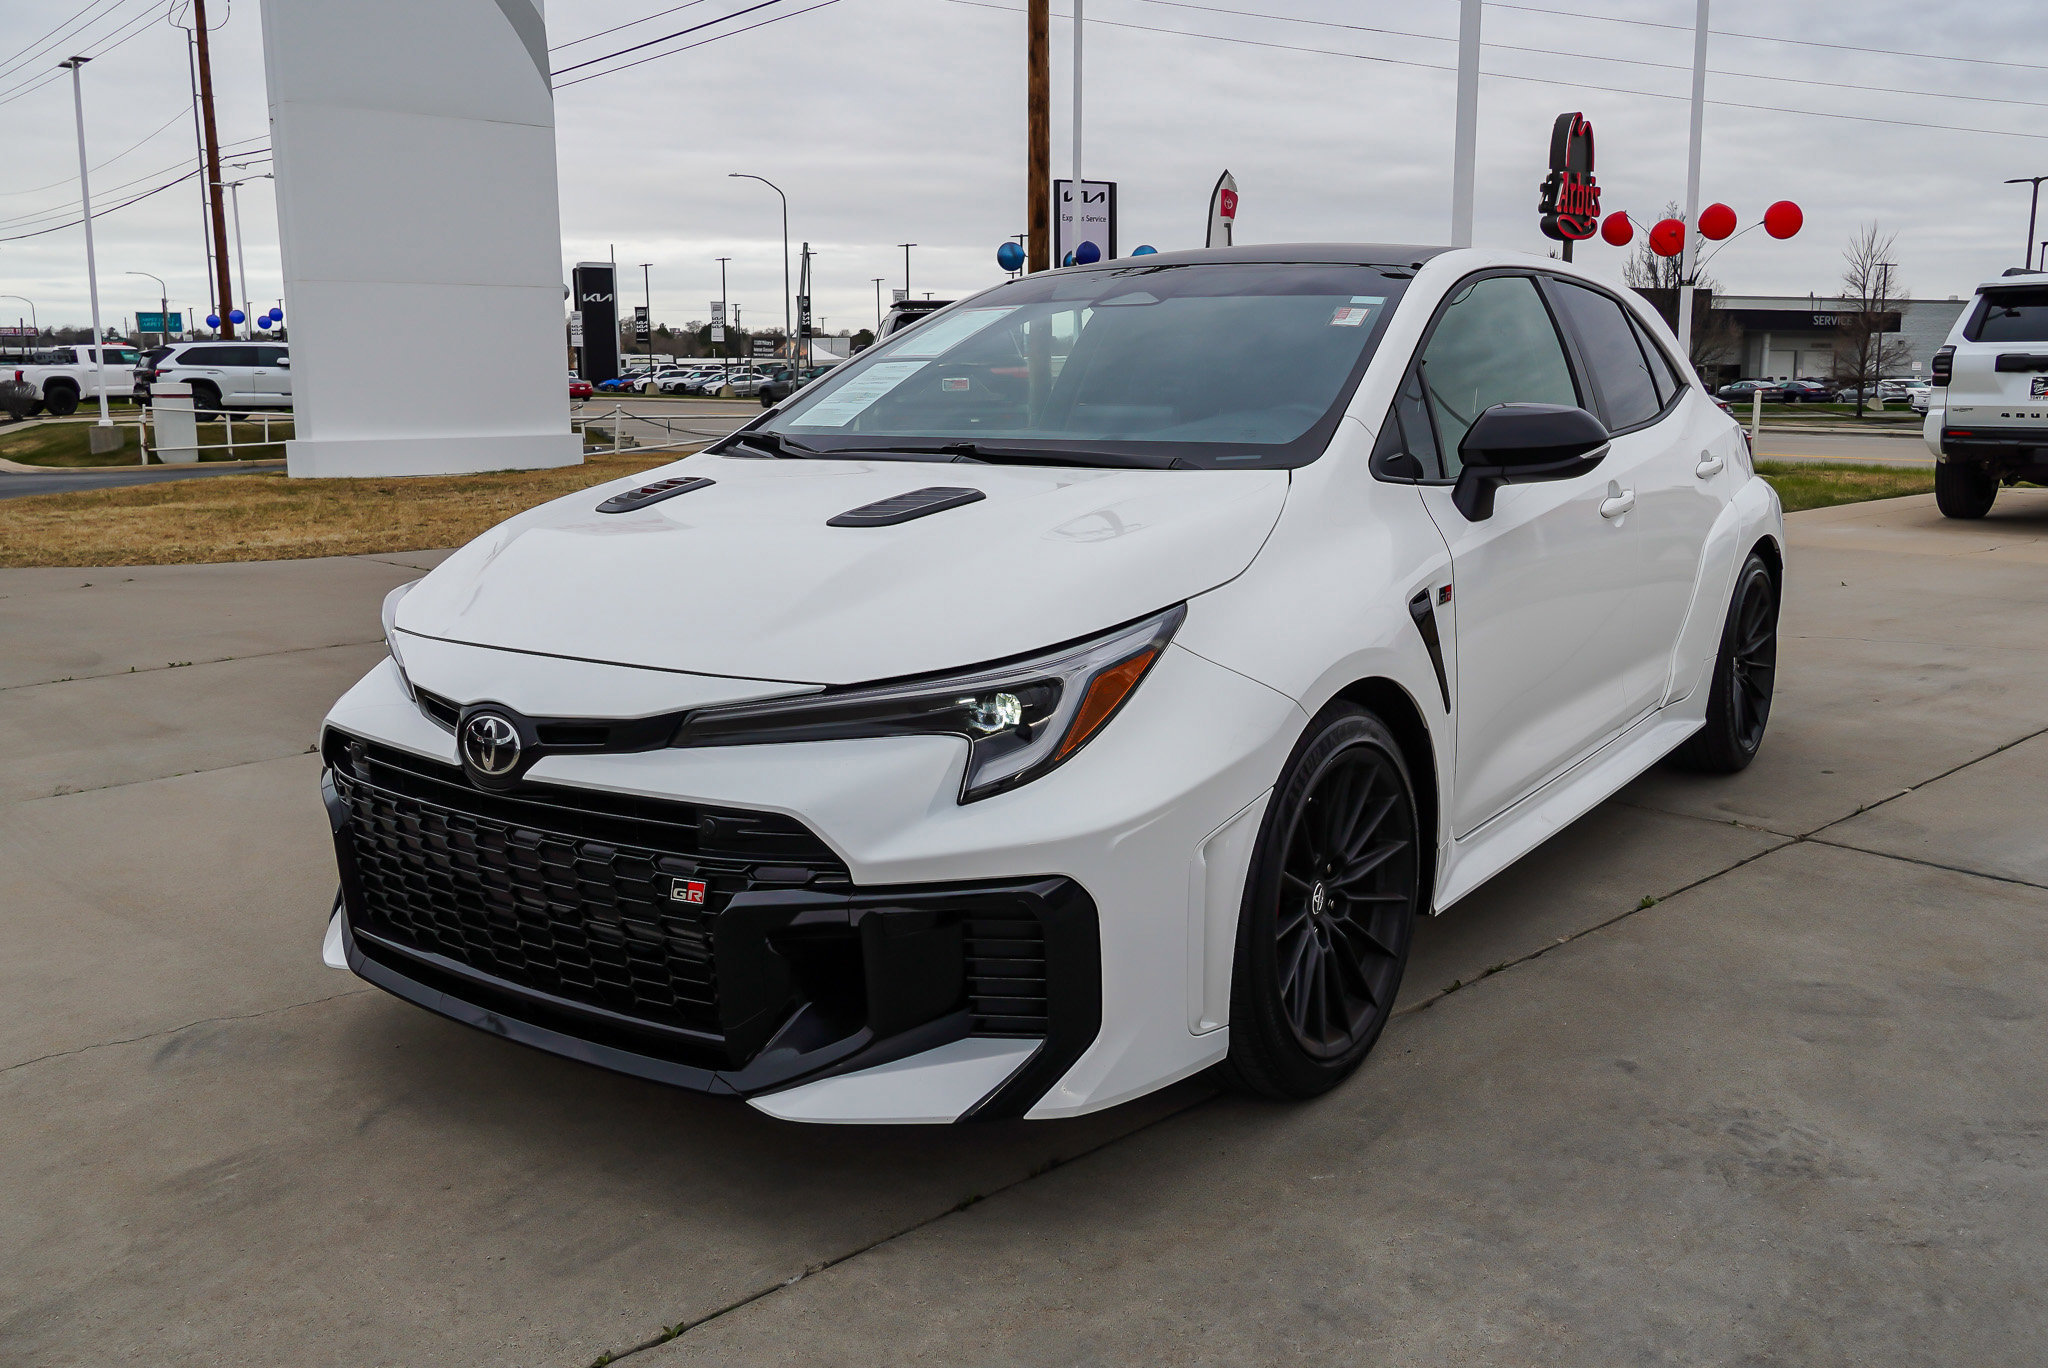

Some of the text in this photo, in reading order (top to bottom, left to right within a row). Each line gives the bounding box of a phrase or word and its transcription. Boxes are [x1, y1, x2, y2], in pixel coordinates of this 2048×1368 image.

[1062, 214, 1107, 223] Exps Service
[583, 293, 613, 302] KIA
[1813, 315, 1852, 326] SERVICE
[673, 888, 702, 902] GR
